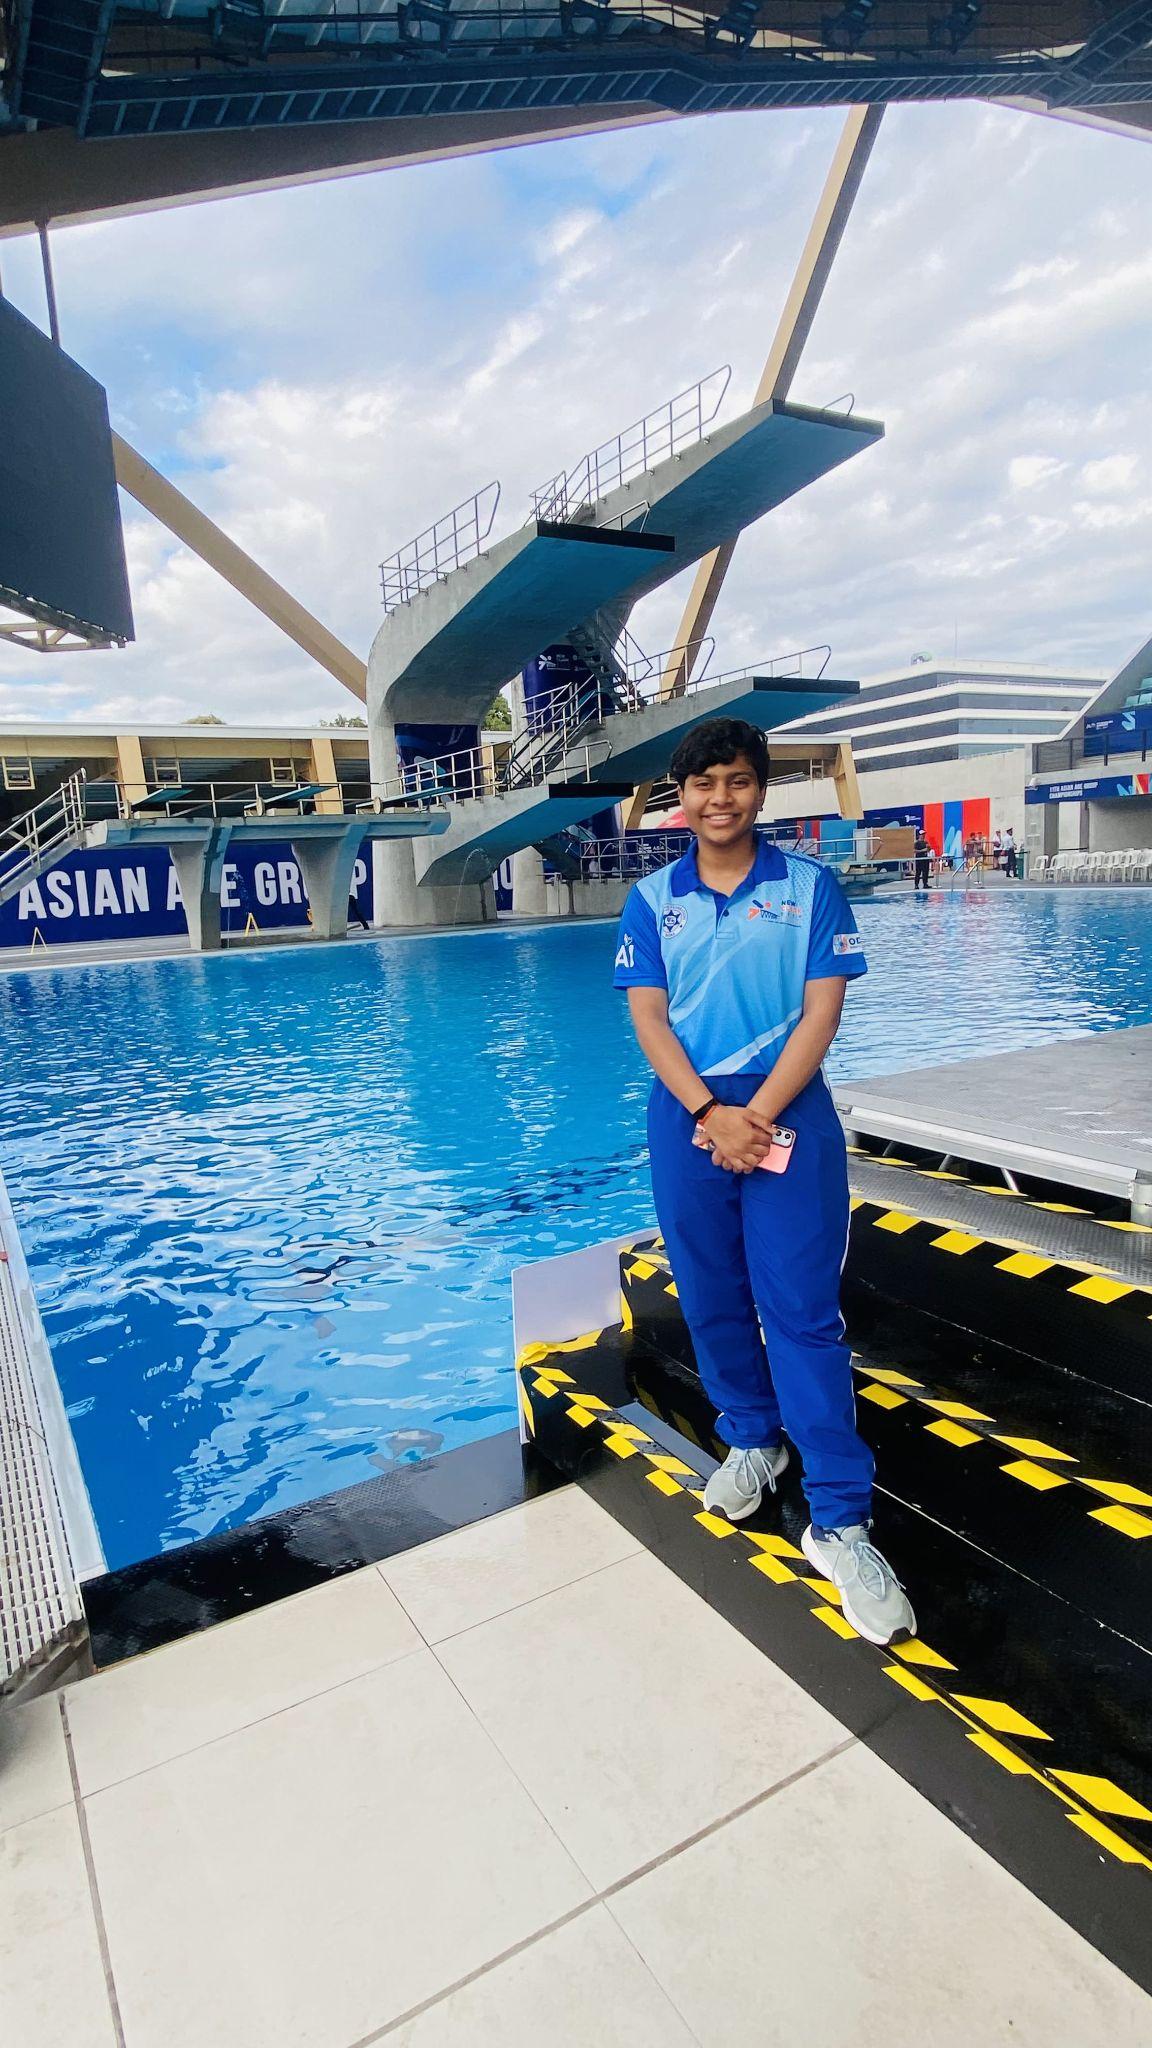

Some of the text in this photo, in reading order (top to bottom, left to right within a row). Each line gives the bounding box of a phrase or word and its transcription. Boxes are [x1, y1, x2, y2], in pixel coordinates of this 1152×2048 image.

[18, 866, 150, 920] ASIAN
[166, 864, 241, 912] AE
[254, 859, 367, 905] GRP
